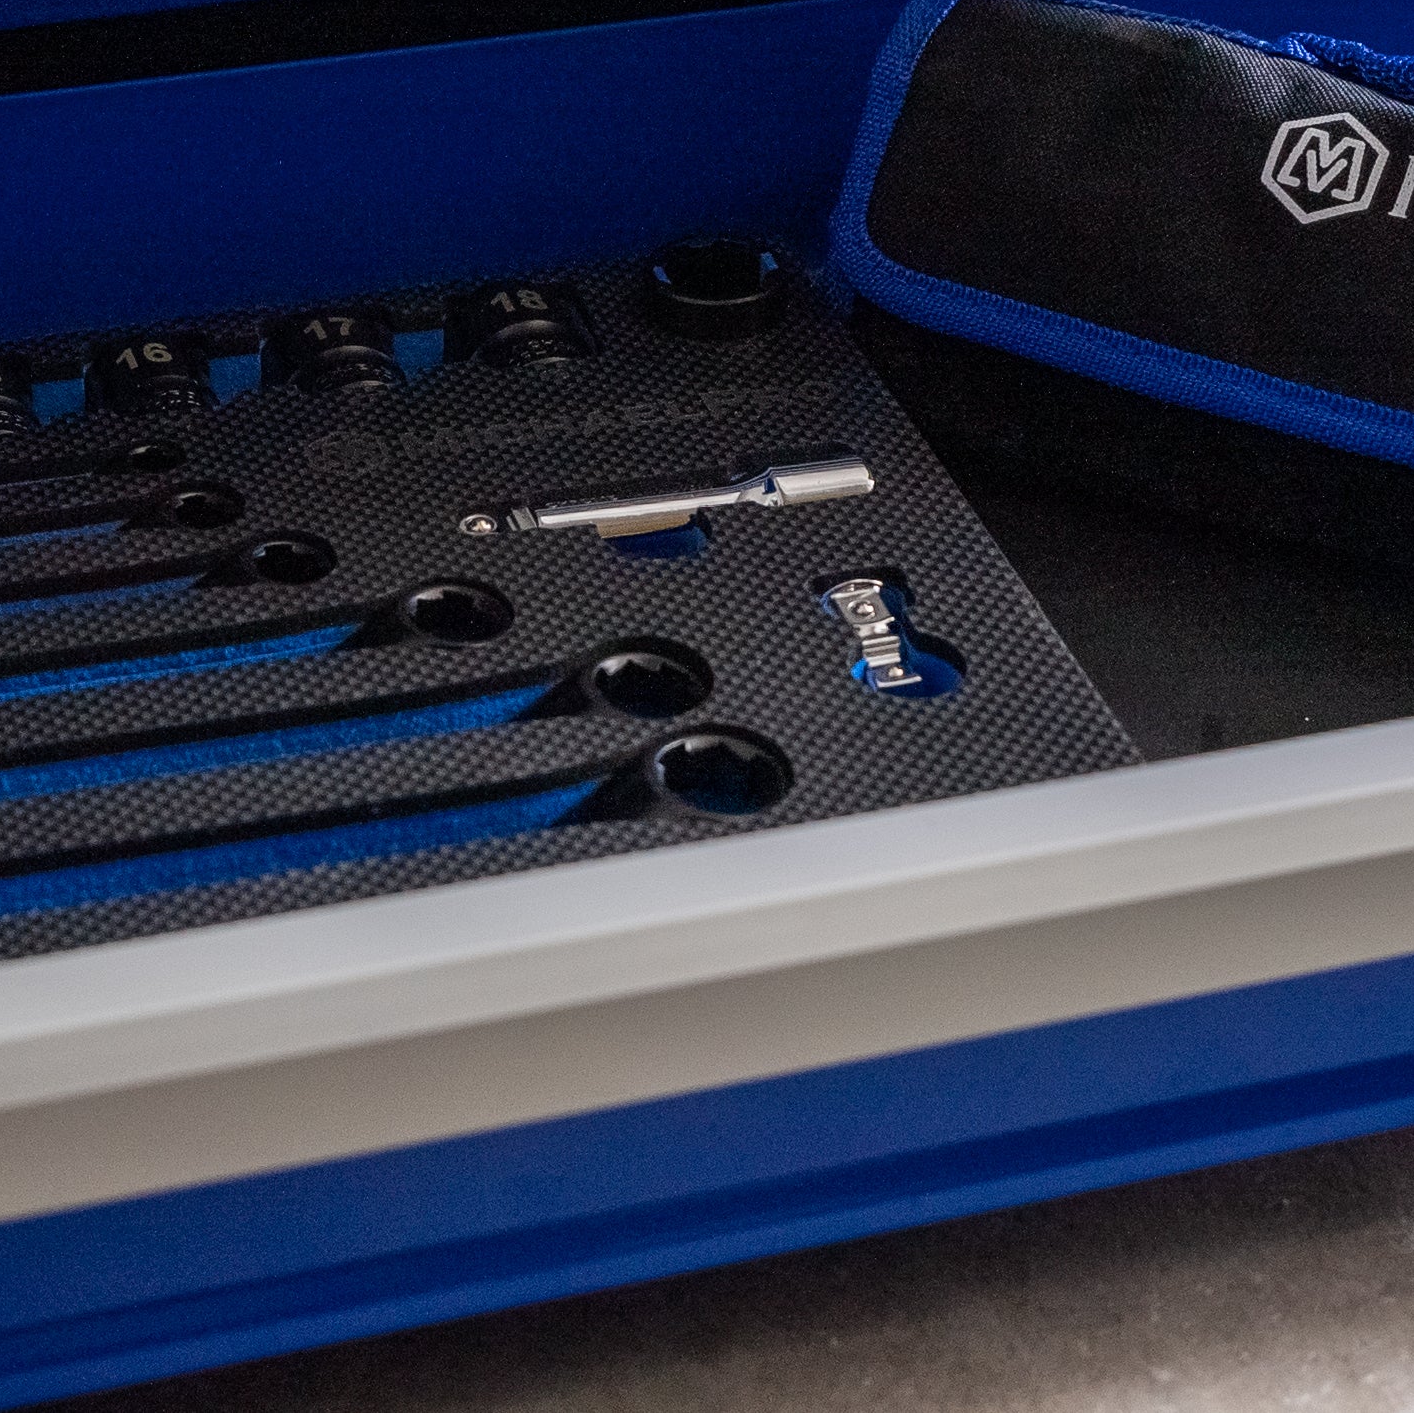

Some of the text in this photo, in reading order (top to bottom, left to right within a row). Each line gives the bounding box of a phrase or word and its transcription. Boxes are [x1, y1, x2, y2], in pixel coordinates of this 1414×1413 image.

[490, 289, 548, 313] 18
[303, 316, 355, 341] 17
[115, 342, 173, 370] 16
